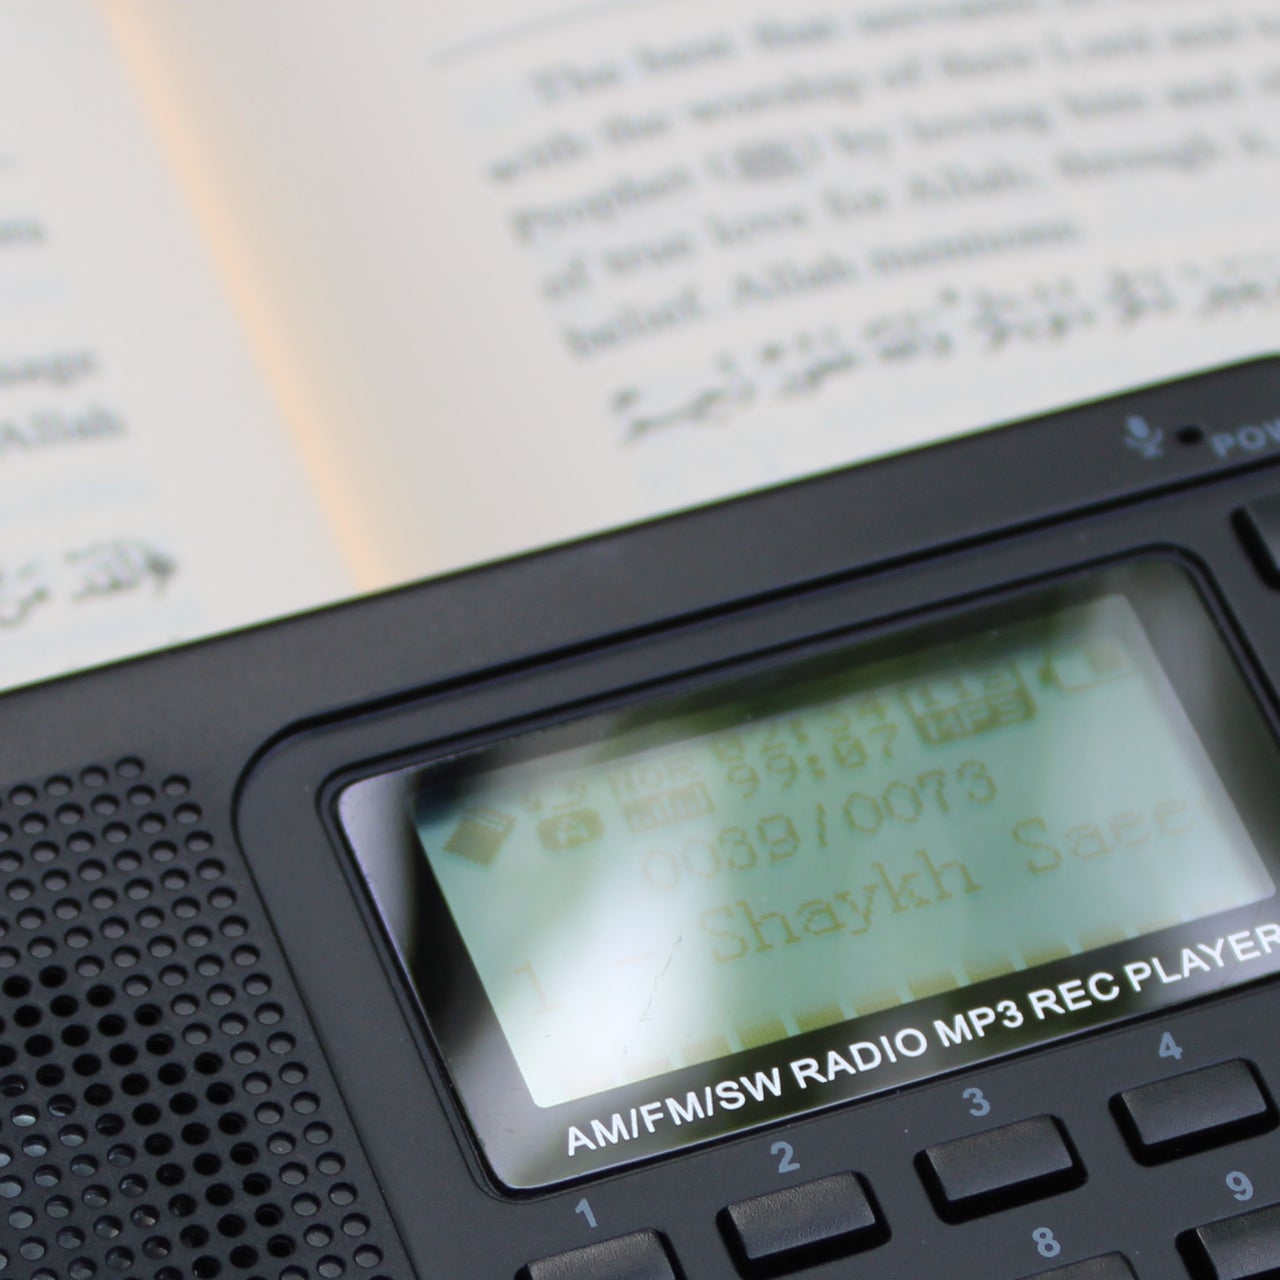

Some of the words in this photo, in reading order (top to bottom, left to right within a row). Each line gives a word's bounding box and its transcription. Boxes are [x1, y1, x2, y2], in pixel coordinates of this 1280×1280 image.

[700, 850, 982, 965] Shaykh
[1157, 1032, 1184, 1062] 4
[565, 1071, 785, 1157] AM/FM/SW
[790, 1027, 929, 1089] RADIO
[934, 998, 1025, 1050] MP3
[1029, 971, 1121, 1024] REC
[963, 1087, 991, 1118] 3
[769, 1141, 801, 1174] 2
[1225, 1171, 1254, 1202] 9
[575, 1198, 599, 1228] 1
[1032, 1226, 1062, 1259] 8
